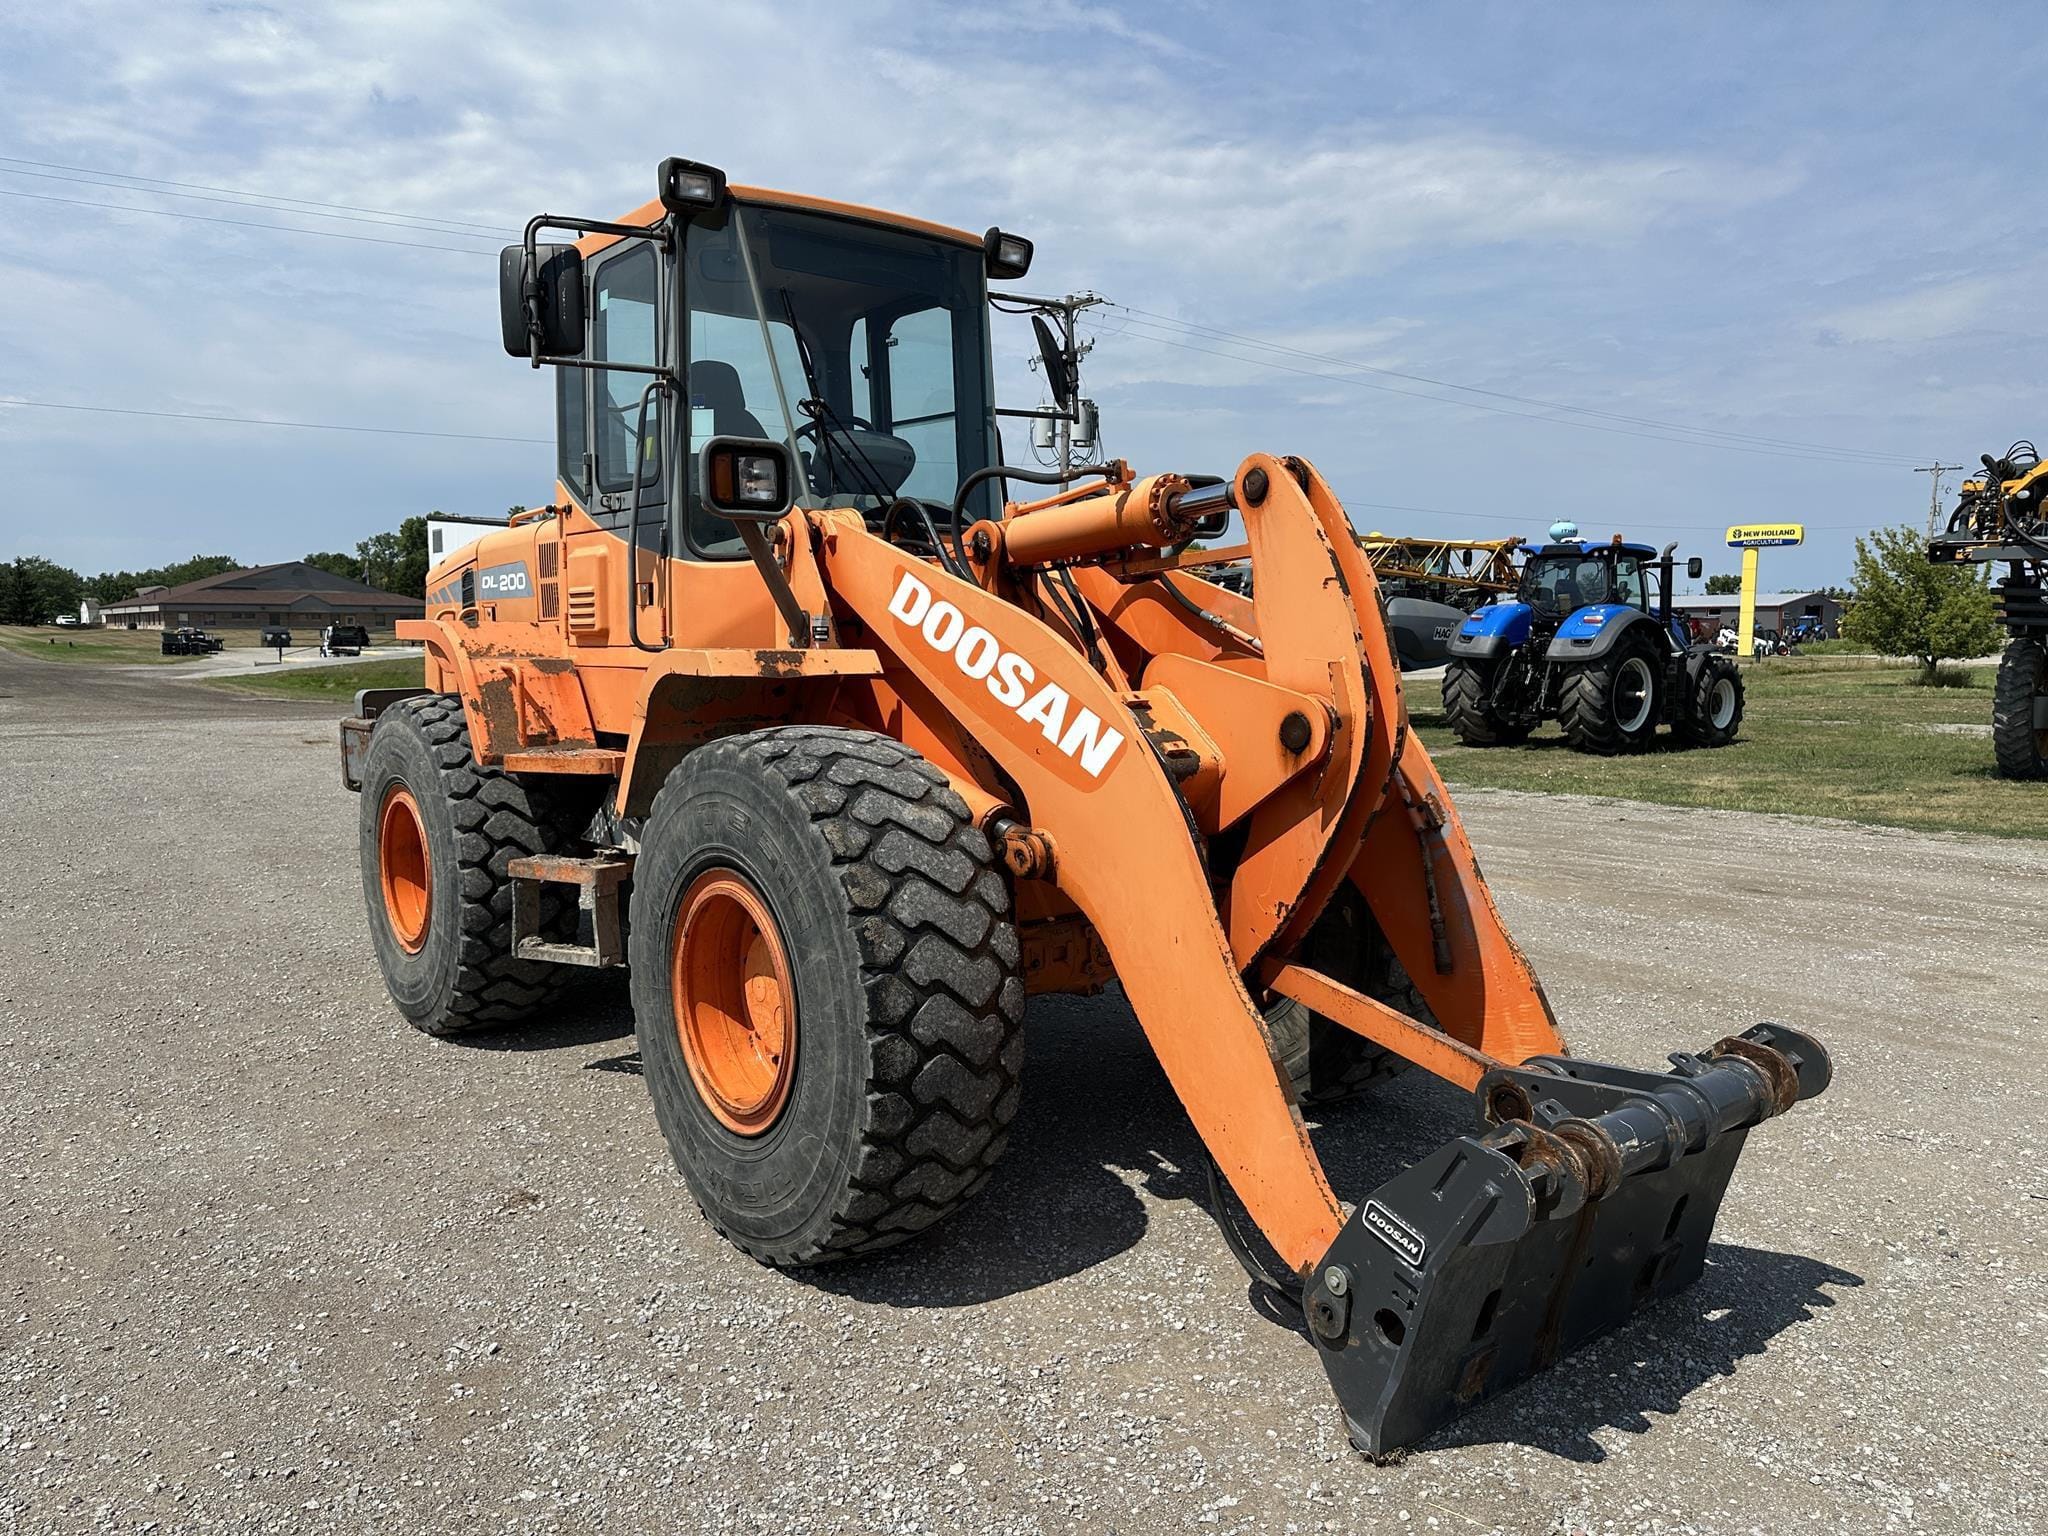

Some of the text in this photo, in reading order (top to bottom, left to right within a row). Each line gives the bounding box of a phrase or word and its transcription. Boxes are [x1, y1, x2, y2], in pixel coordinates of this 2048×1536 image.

[482, 572, 526, 591] DL 200
[887, 571, 1125, 778] DOOSAN
[1368, 1211, 1418, 1254] DOOSAN
